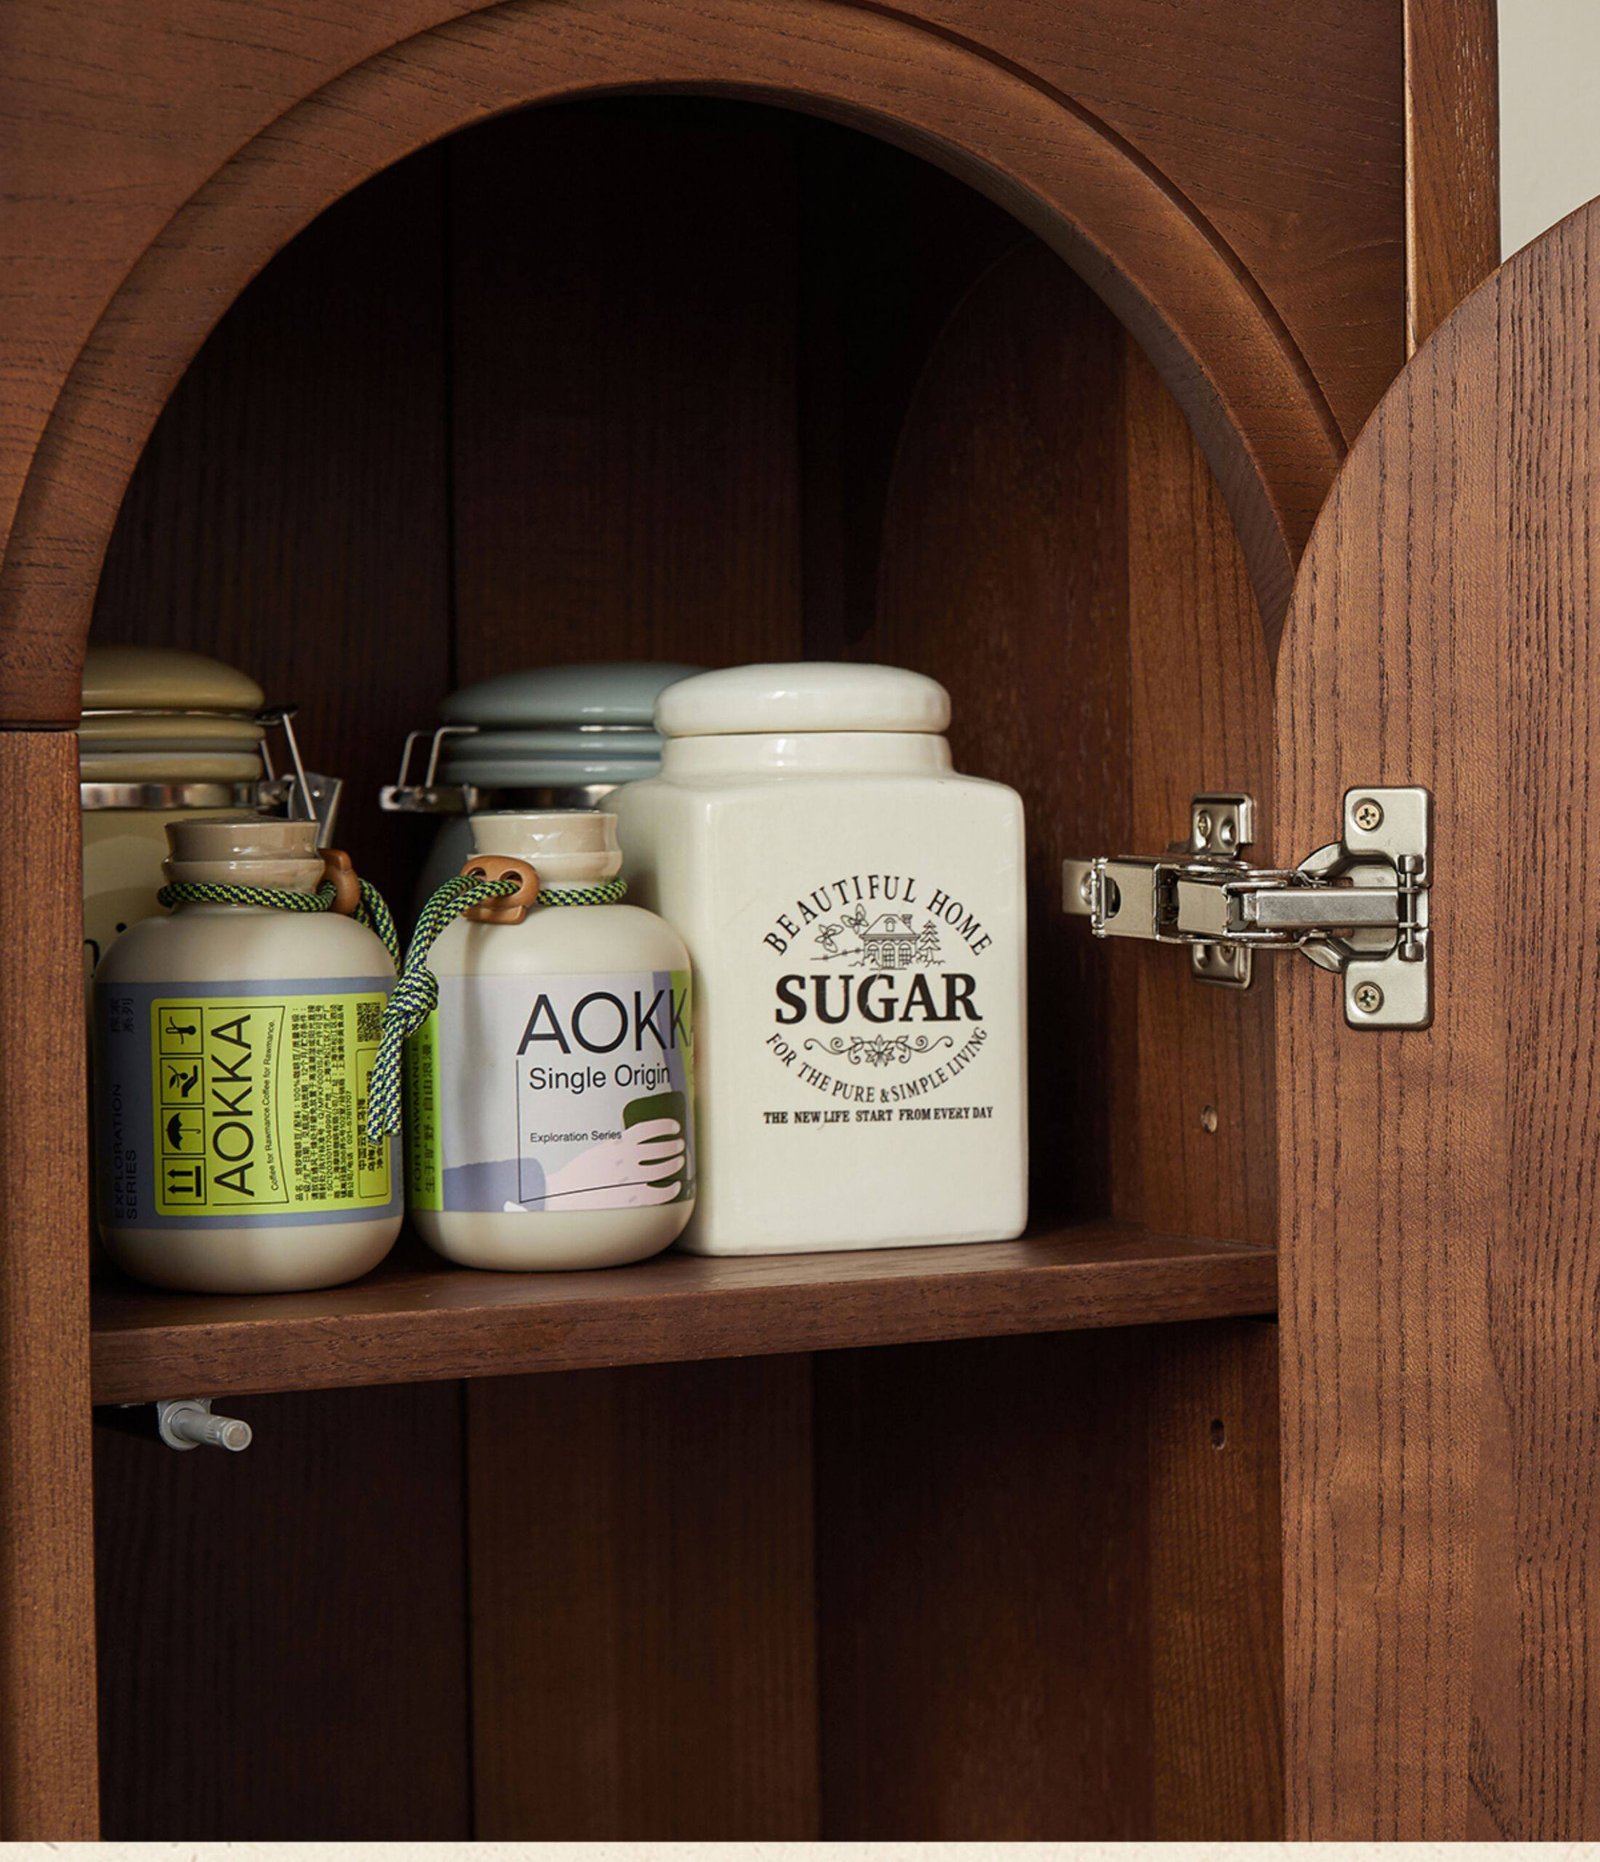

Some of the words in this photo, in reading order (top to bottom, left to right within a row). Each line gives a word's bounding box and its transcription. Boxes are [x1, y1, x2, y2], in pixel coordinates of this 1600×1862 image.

[763, 874, 917, 957] BEAUTIFUL
[926, 888, 992, 956] HOME
[775, 973, 983, 1024] SUGAR
[529, 1066, 606, 1094] Single
[614, 1064, 670, 1090] Origin
[766, 1032, 797, 1067] FOR
[797, 1062, 831, 1092] THE
[831, 1080, 875, 1103] PURE
[891, 1068, 949, 1102] SIMPLE
[947, 1027, 988, 1075] LIVING
[211, 1014, 255, 1197] AOKKA
[763, 1112, 788, 1124] THE
[794, 1111, 820, 1123] NEW
[823, 1110, 849, 1122] LIFE
[855, 1109, 893, 1122] START
[899, 1108, 932, 1121] FROM
[934, 1108, 970, 1120] EVERY
[972, 1107, 993, 1119] DAY
[111, 1084, 125, 1219] EXPLORATION
[267, 1153, 275, 1165] for
[530, 1132, 588, 1144] Exploration
[591, 1130, 622, 1141] Series
[126, 1150, 137, 1220] SERIES
[266, 1167, 279, 1191] Coffee
